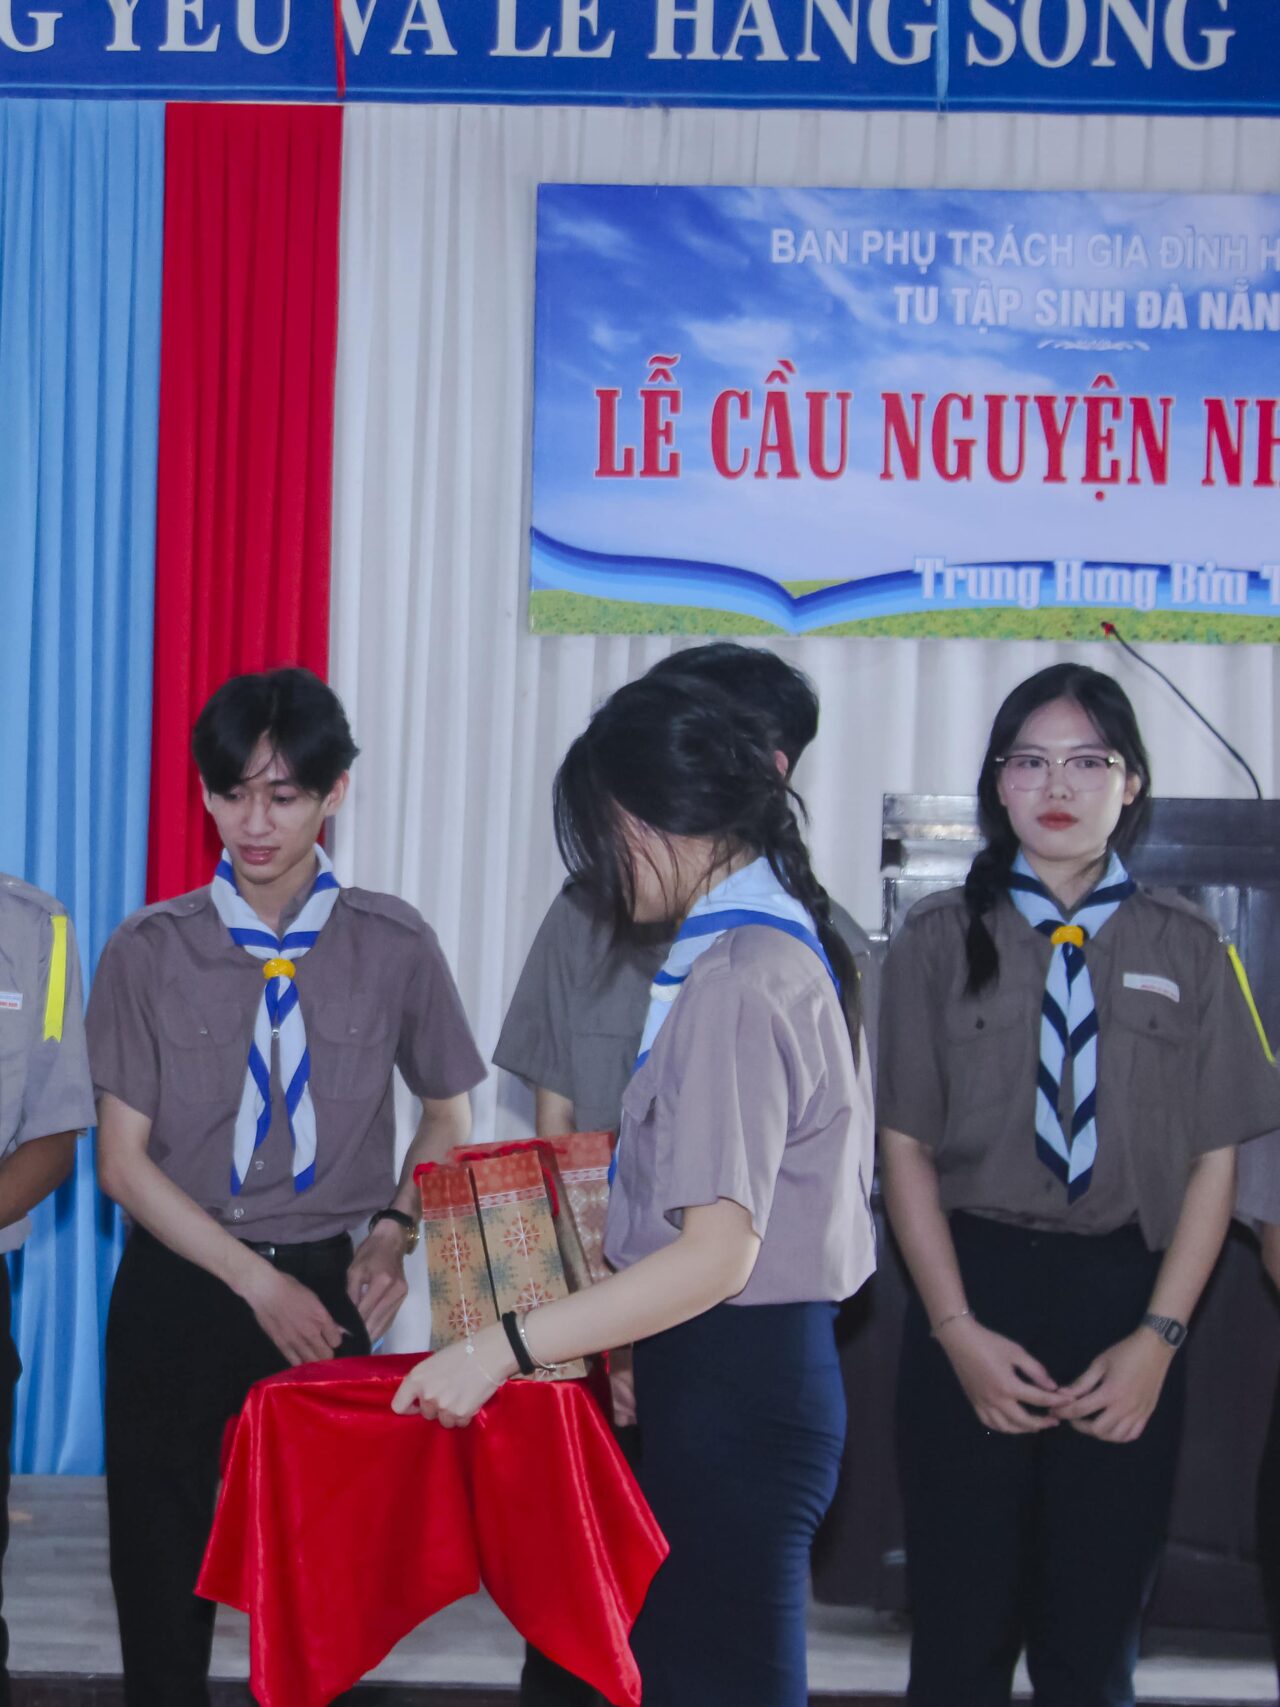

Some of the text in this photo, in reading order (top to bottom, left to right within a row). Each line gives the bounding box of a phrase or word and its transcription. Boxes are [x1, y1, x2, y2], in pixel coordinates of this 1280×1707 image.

[772, 228, 848, 264] BAN
[862, 230, 936, 274] PHỤ
[948, 224, 1073, 267] TRÁCH
[1088, 233, 1148, 268] GIA
[1160, 225, 1247, 271] ĐÌNH
[894, 286, 939, 325] TU
[951, 279, 1023, 334] TẬP
[1035, 288, 1125, 329] SINH
[1136, 282, 1188, 329] ĐÀ
[595, 354, 682, 478] LỄ
[711, 359, 853, 480] CẦU
[880, 373, 1174, 500] NGUYỆN
[914, 557, 1043, 609] Trung
